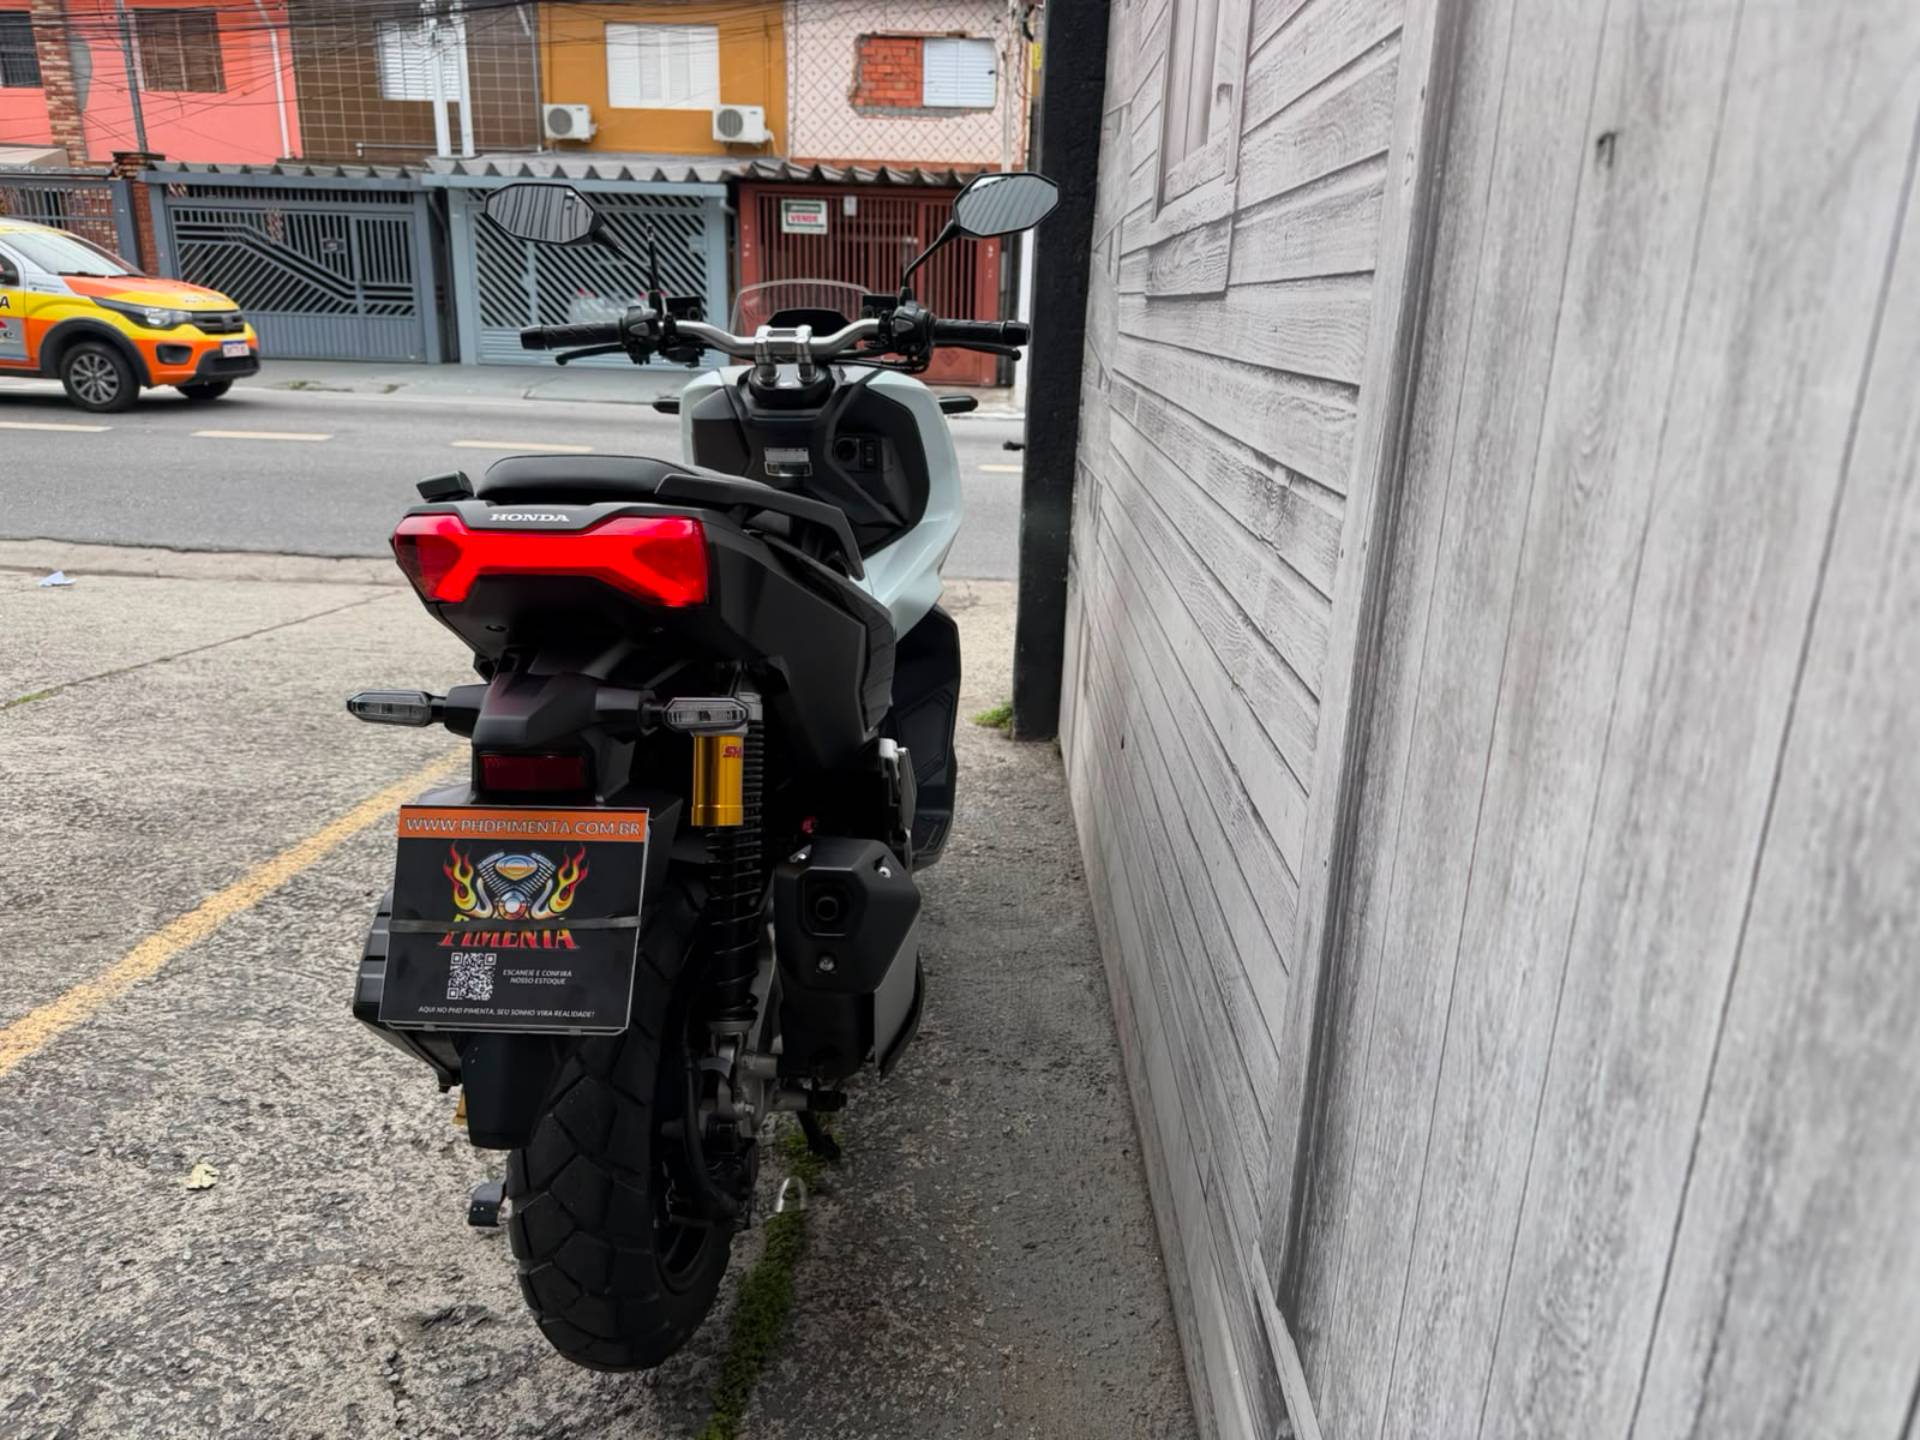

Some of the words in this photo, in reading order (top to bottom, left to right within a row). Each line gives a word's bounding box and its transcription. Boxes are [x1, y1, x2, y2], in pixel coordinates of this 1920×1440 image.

[490, 513, 570, 522] HONDA
[723, 745, 744, 758] SH
[406, 818, 641, 836] WWW.PHDPIMENTA.COM.BR
[535, 977, 566, 985] ESTOQUE
[418, 1006, 435, 1014] AQUI
[436, 1006, 447, 1014] NO
[536, 1009, 553, 1017] VIRA
